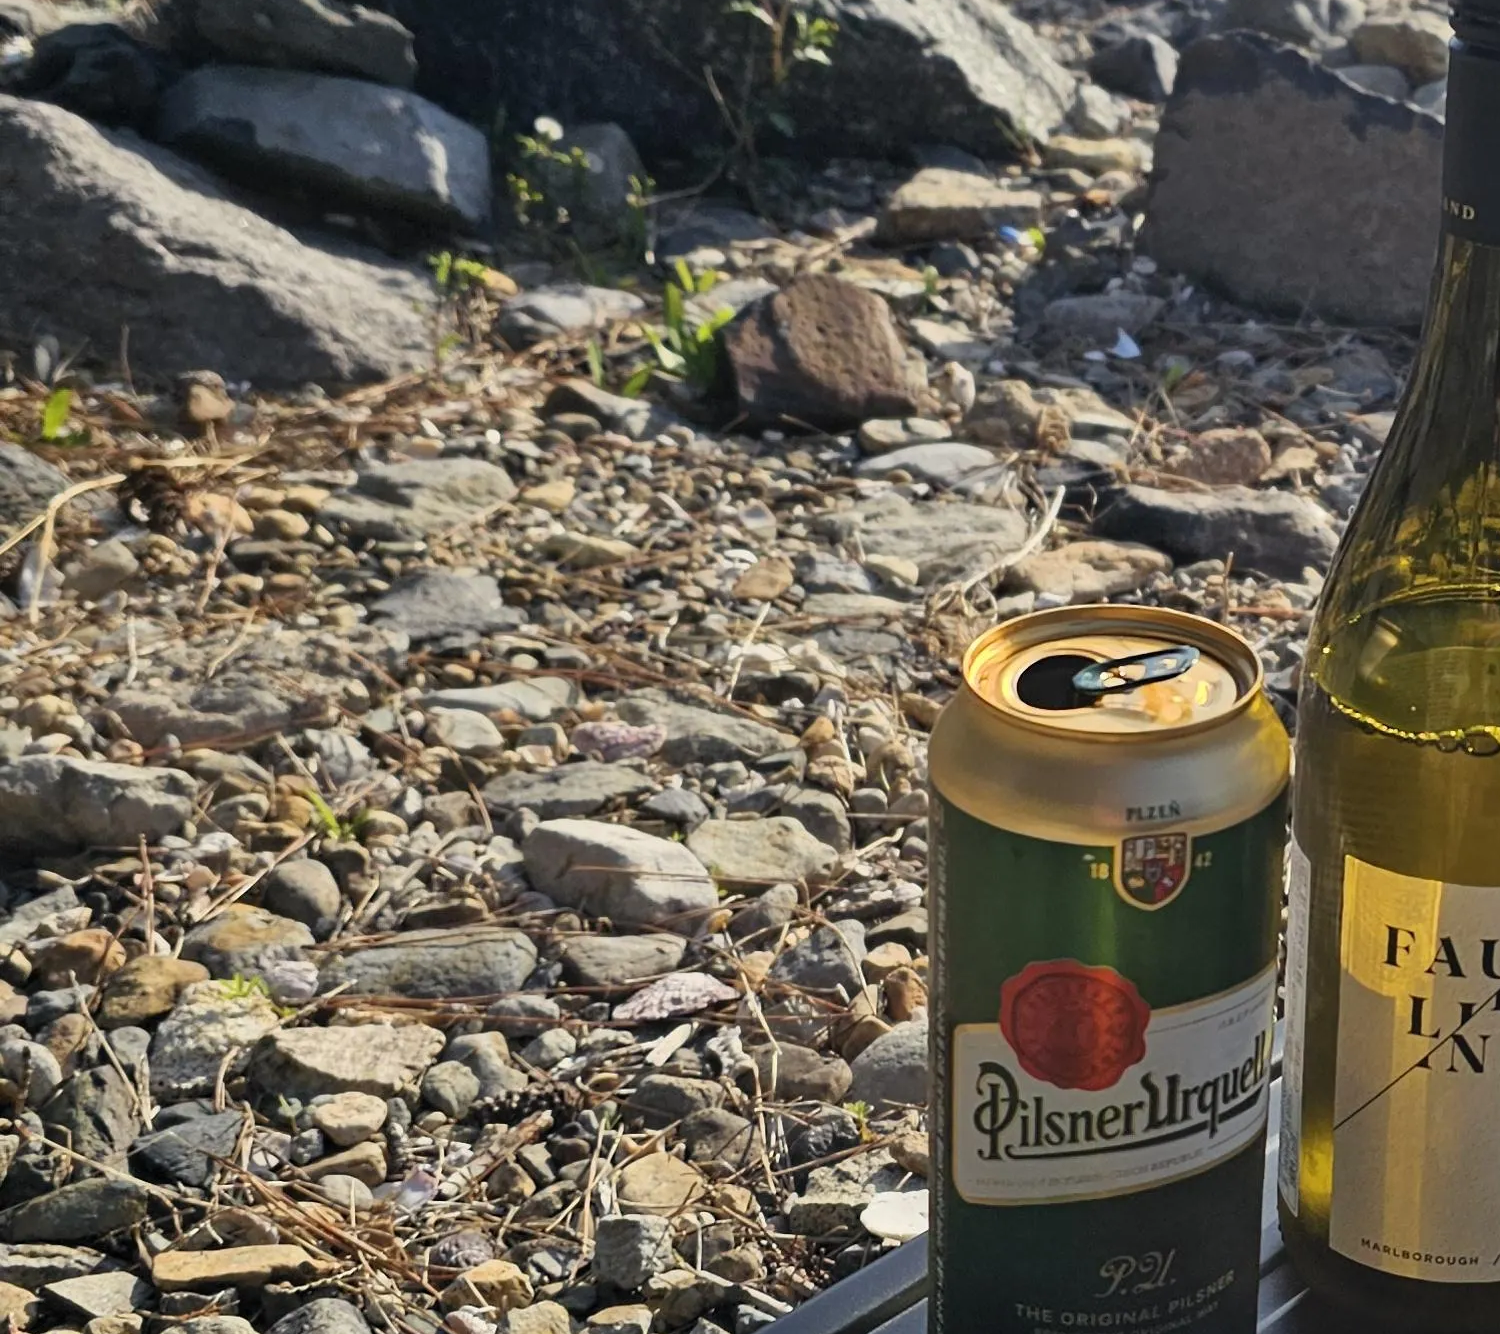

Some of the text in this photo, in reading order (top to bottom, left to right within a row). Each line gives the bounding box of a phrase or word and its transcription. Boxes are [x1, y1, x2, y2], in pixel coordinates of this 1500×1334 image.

[1091, 850, 1213, 880] 18 42
[973, 1029, 1266, 1161] Pilsner Urquell
[1361, 1237, 1479, 1266] MARLBOROUGH
[1015, 1268, 1235, 1327] THE ORIGINAL PILSNER
